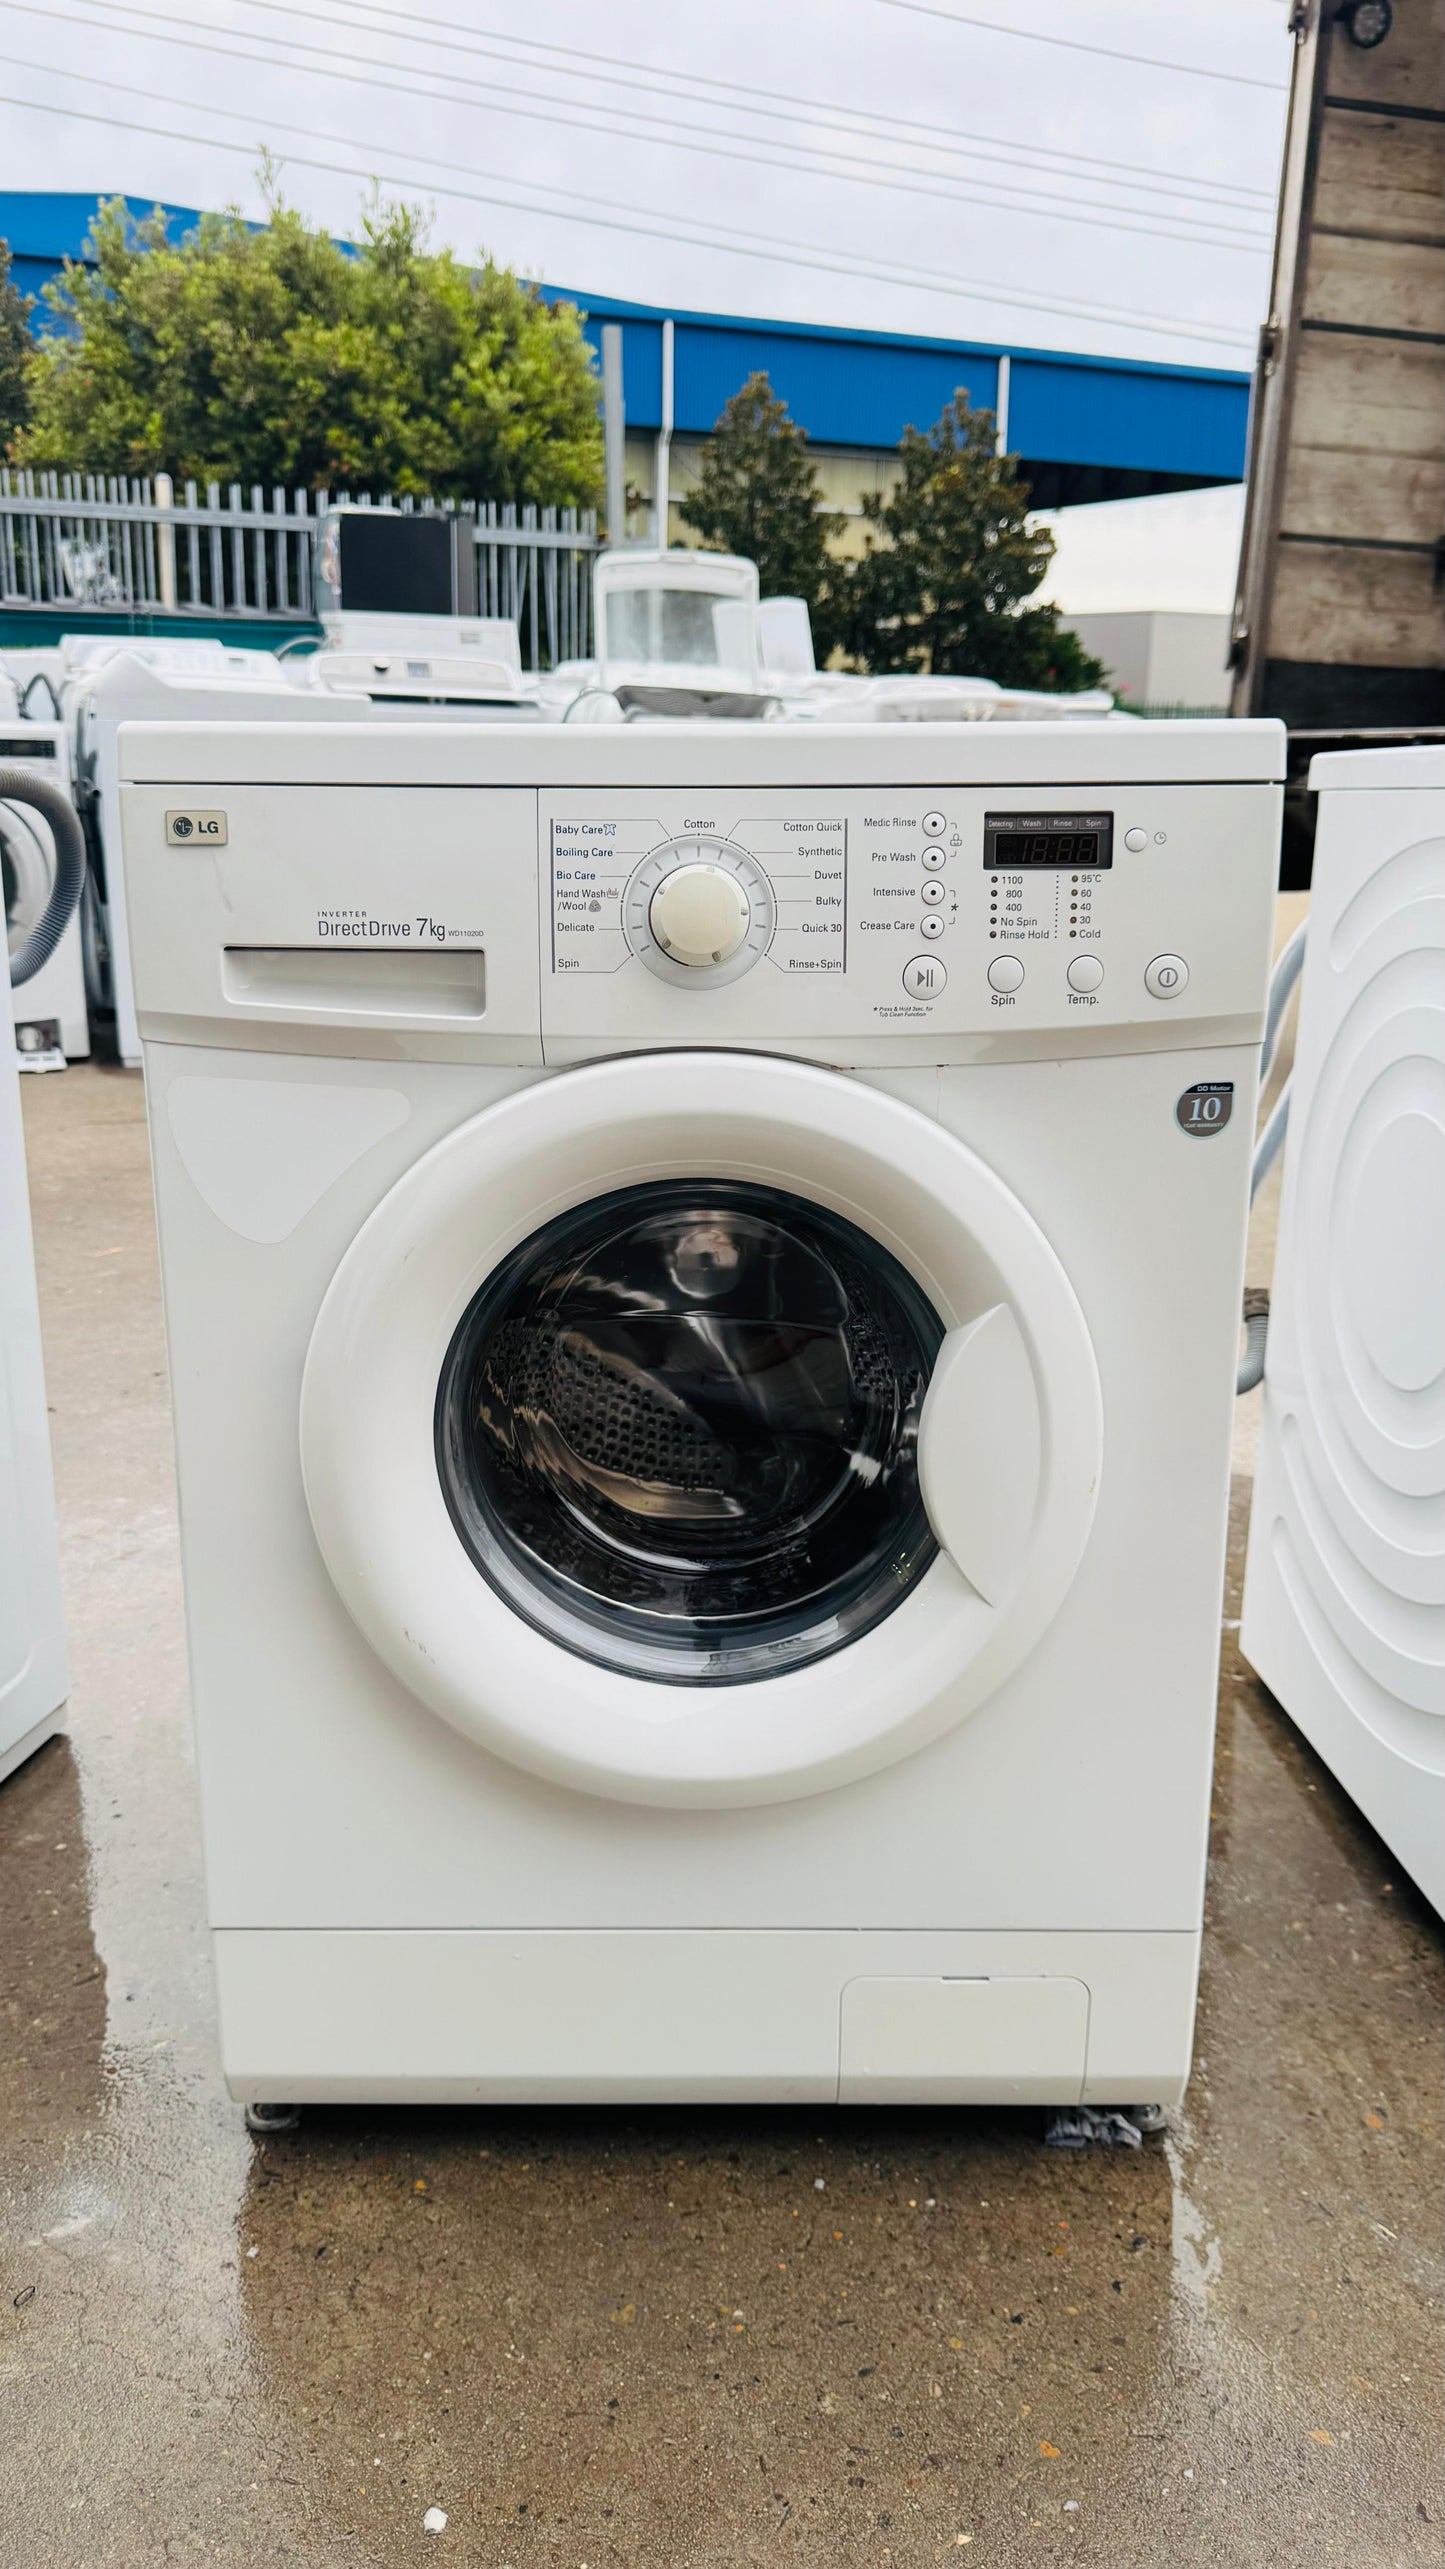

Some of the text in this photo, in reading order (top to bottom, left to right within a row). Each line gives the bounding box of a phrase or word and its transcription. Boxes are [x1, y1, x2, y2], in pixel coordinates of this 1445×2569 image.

[197, 820, 219, 834] LG
[683, 818, 716, 829] Cotton
[783, 821, 843, 832] Cotton Quick
[863, 817, 917, 827] Medic Rinse
[1022, 819, 1042, 827] Wash
[1053, 819, 1073, 827] Rinse
[1086, 819, 1102, 828] Spin
[555, 824, 603, 836] Baby Care
[555, 847, 614, 859] Boiling Care
[797, 846, 843, 858] Synthetic
[871, 852, 917, 862] Pre Wash
[556, 870, 596, 881] Bio Care
[814, 870, 843, 880] Duvet
[1001, 876, 1024, 885] 1100
[556, 889, 607, 899] Hand Wash
[872, 887, 916, 897] Intensive
[1005, 889, 1023, 899] 800
[1080, 889, 1093, 898] 60
[557, 901, 587, 912] /Wool
[815, 896, 843, 908] Bulky
[1005, 903, 1023, 912] 400
[1079, 902, 1092, 911] 40
[859, 920, 916, 931] Crease Care
[1000, 917, 1038, 928] No Spin
[1079, 916, 1091, 925] 30
[416, 917, 446, 942] 7kg
[557, 922, 595, 932] Delicate
[801, 923, 843, 934] Quick 30
[1000, 930, 1050, 940] Rinse Hold
[1079, 929, 1102, 939] Cold
[557, 958, 580, 971] Spin
[789, 959, 842, 971] Rinse+Spin
[990, 994, 1016, 1008] Spin
[1066, 994, 1100, 1008] Temp.
[1189, 1097, 1221, 1121] 10
